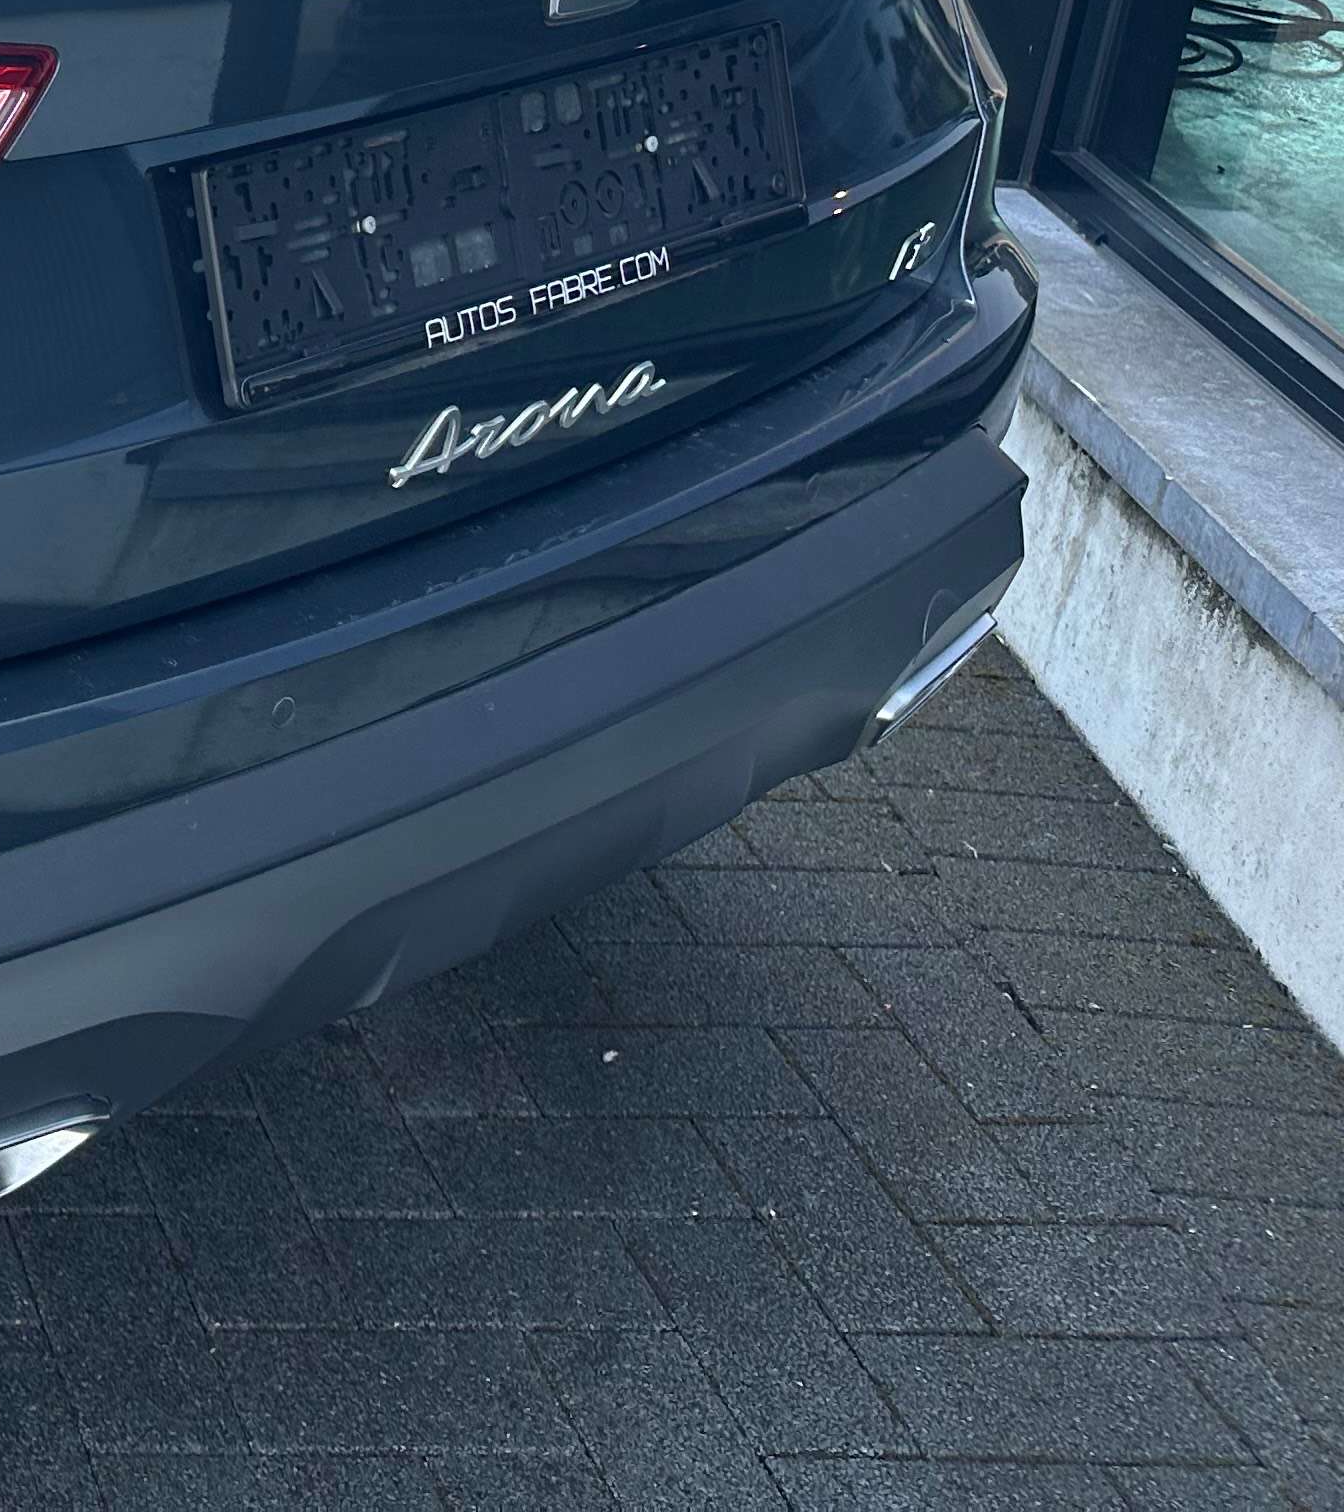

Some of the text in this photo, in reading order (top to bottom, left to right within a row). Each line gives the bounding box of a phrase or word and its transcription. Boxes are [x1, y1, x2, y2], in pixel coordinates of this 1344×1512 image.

[424, 245, 670, 349] AUTOS FABRE.COM
[388, 360, 666, 488] Arona
